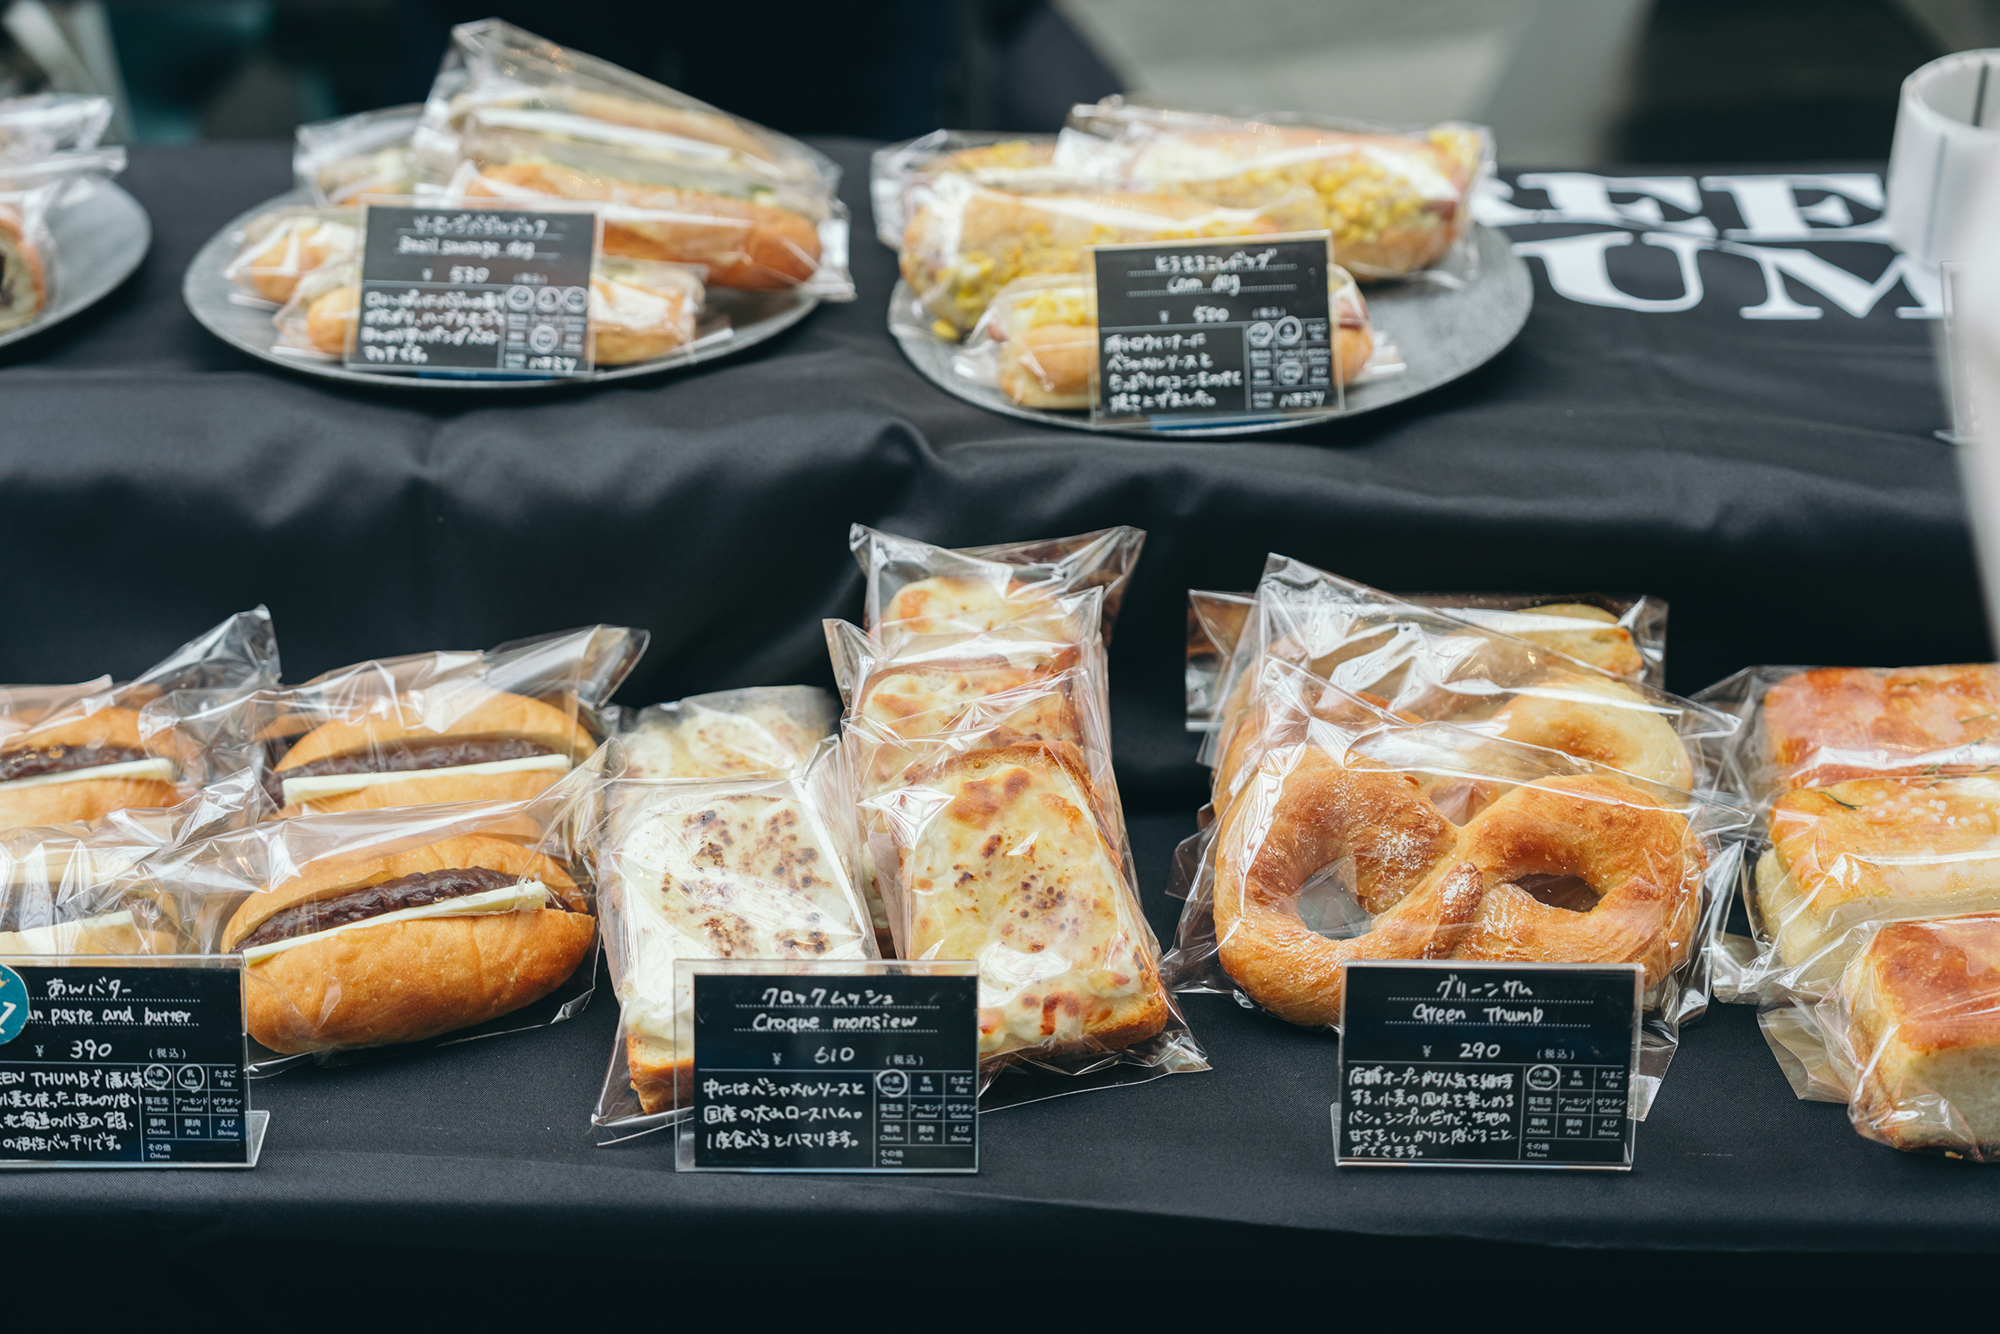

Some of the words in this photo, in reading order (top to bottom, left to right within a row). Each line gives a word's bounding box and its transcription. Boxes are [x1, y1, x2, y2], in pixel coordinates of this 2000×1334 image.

[506, 239, 536, 261] dog
[449, 265, 490, 285] 530
[1211, 273, 1241, 296] dog
[1193, 305, 1229, 324] 500
[46, 977, 132, 999] あんバター
[51, 1007, 93, 1026] paste
[102, 1006, 135, 1022] and
[144, 1007, 191, 1025] butter
[1413, 1003, 1466, 1023] Green
[1483, 1006, 1544, 1024] Thumb
[752, 1012, 820, 1034] Croque
[35, 1045, 44, 1057] ¥
[70, 1038, 112, 1059] 390
[148, 1048, 187, 1059] (税込)
[772, 1052, 782, 1064] ¥
[814, 1046, 855, 1063] 610
[1422, 1045, 1432, 1057] ¥
[1459, 1042, 1501, 1059] 290
[1536, 1048, 1575, 1060] (税込)
[148, 1069, 164, 1077] 小麦
[215, 1070, 237, 1078] たまご
[950, 1076, 973, 1084] たまご
[1601, 1071, 1624, 1079] たまご
[1596, 1098, 1626, 1106] ゼラチン
[220, 1119, 235, 1127] えび
[954, 1125, 969, 1133] えび
[1602, 1119, 1617, 1127] えび
[1352, 1141, 1424, 1158] ができます。
